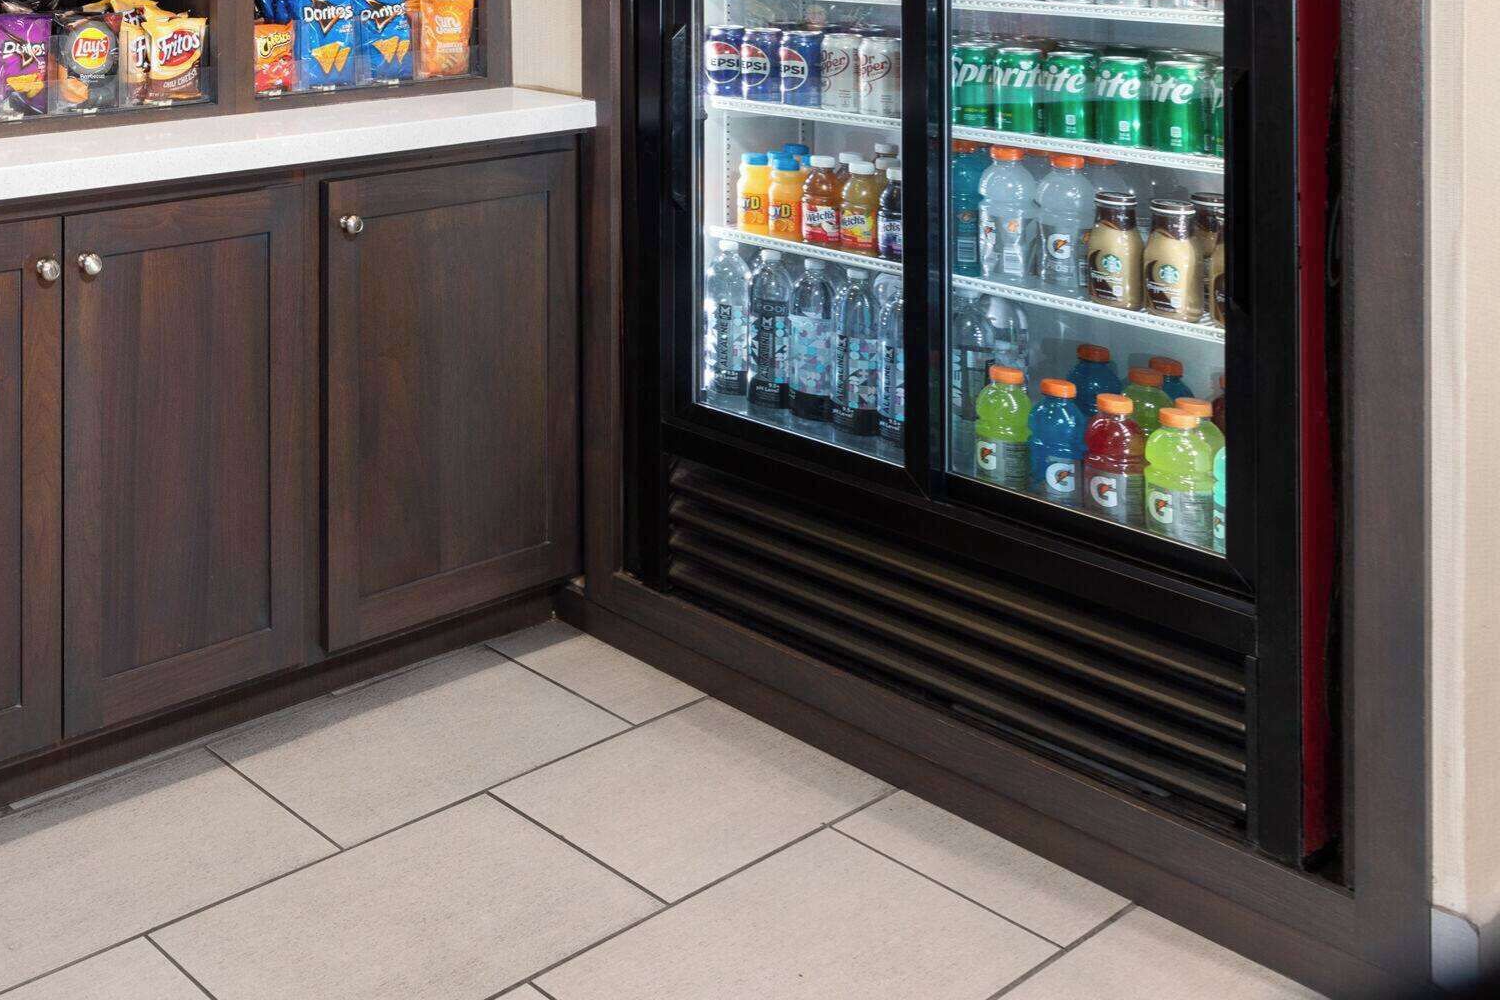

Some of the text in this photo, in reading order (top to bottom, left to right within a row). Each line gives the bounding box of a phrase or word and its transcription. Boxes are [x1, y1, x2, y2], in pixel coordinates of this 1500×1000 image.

[304, 5, 354, 23] Doritos
[360, 2, 405, 21] Doritos
[75, 38, 108, 59] Lay's
[158, 33, 200, 66] Fritos
[257, 31, 291, 57] Cheetos
[177, 68, 197, 85] CHEESE
[806, 209, 835, 222] Welch's
